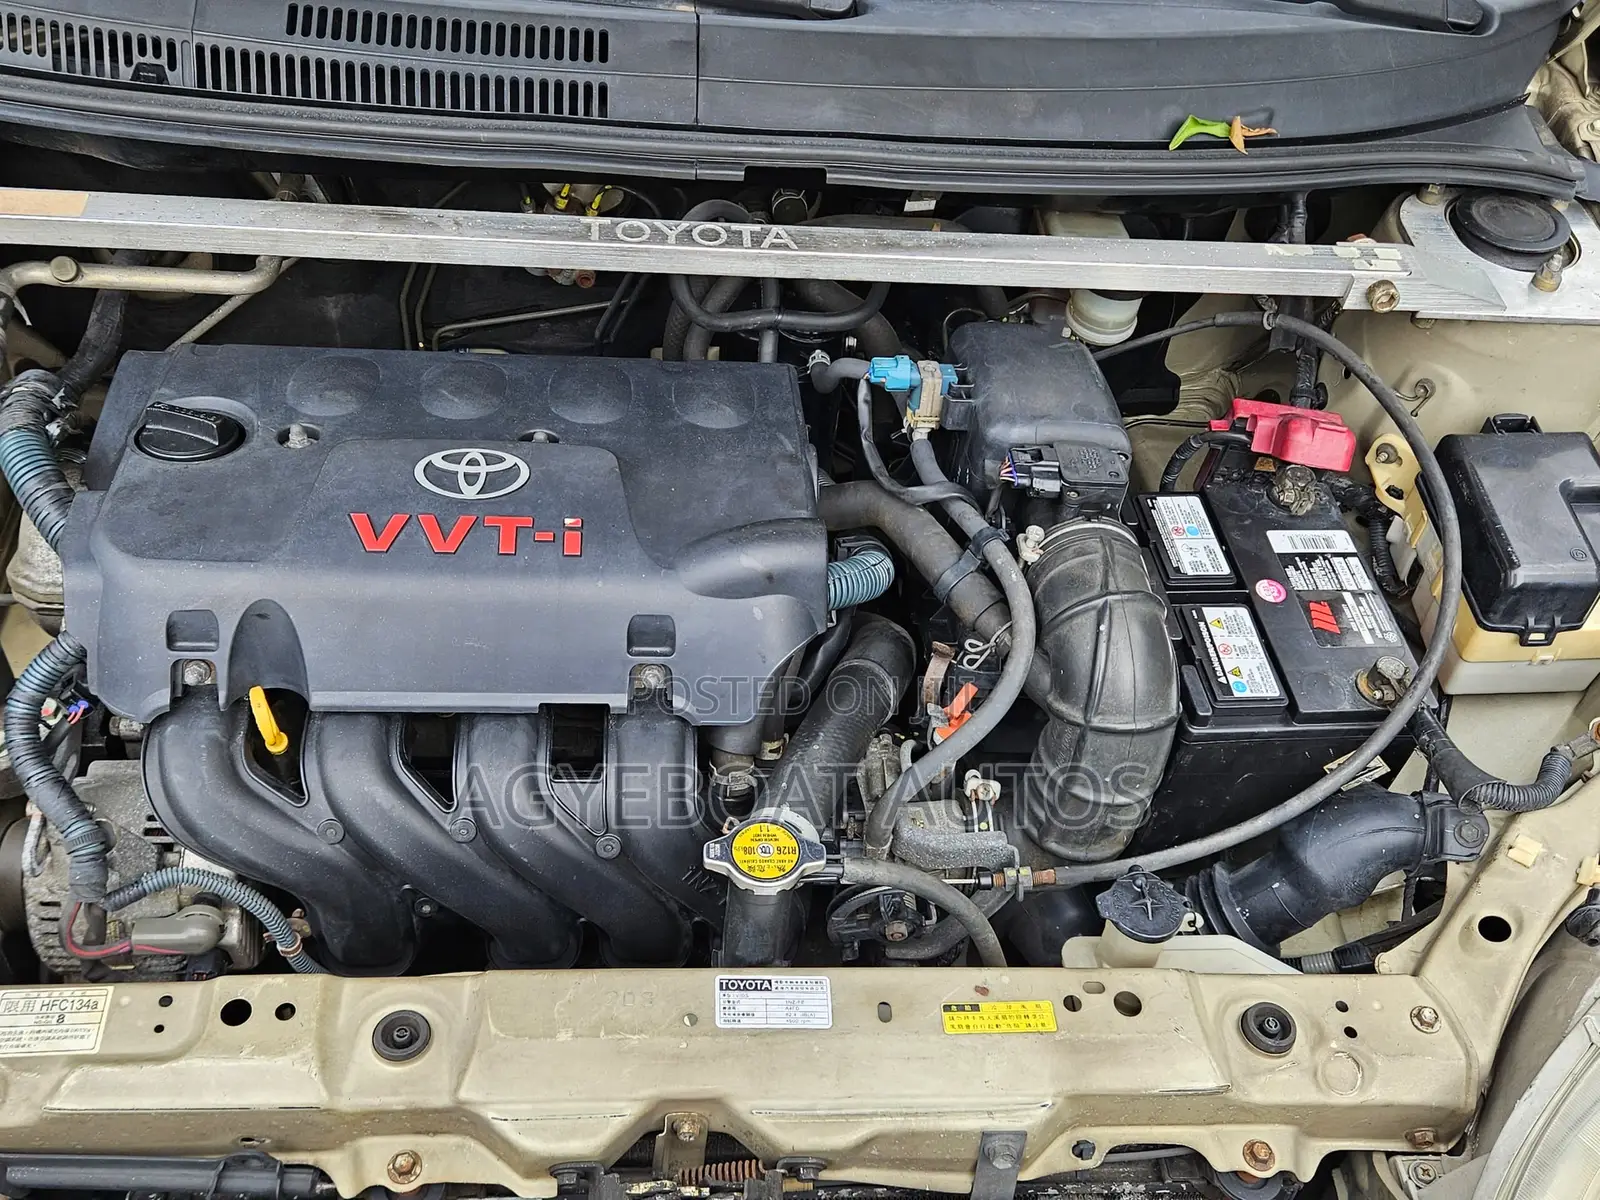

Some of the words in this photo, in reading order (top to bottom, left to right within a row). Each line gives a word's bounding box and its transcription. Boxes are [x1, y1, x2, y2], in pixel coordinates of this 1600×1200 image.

[580, 218, 798, 250] TOYOTA
[348, 512, 583, 557] VVT-i
[744, 846, 756, 855] 108
[777, 846, 797, 855] R126
[720, 980, 771, 990] TOYOTA
[39, 998, 98, 1011] HFC134a
[56, 1013, 66, 1024] 8
